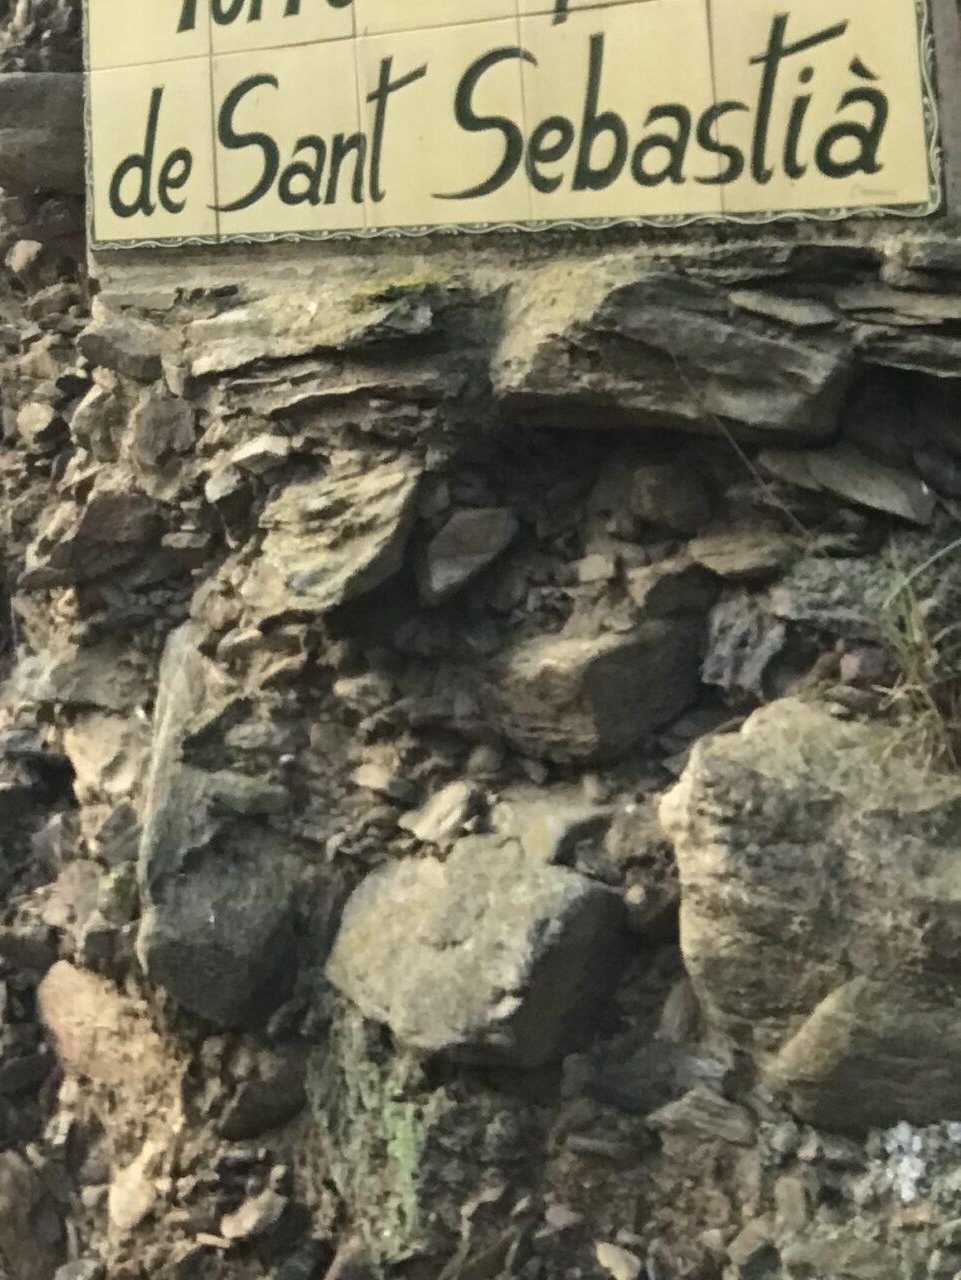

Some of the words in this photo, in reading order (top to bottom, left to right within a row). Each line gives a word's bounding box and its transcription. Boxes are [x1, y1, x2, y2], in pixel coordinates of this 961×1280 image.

[108, 86, 194, 219] de
[206, 55, 429, 215] Sant
[431, 12, 890, 202] Sebastià
